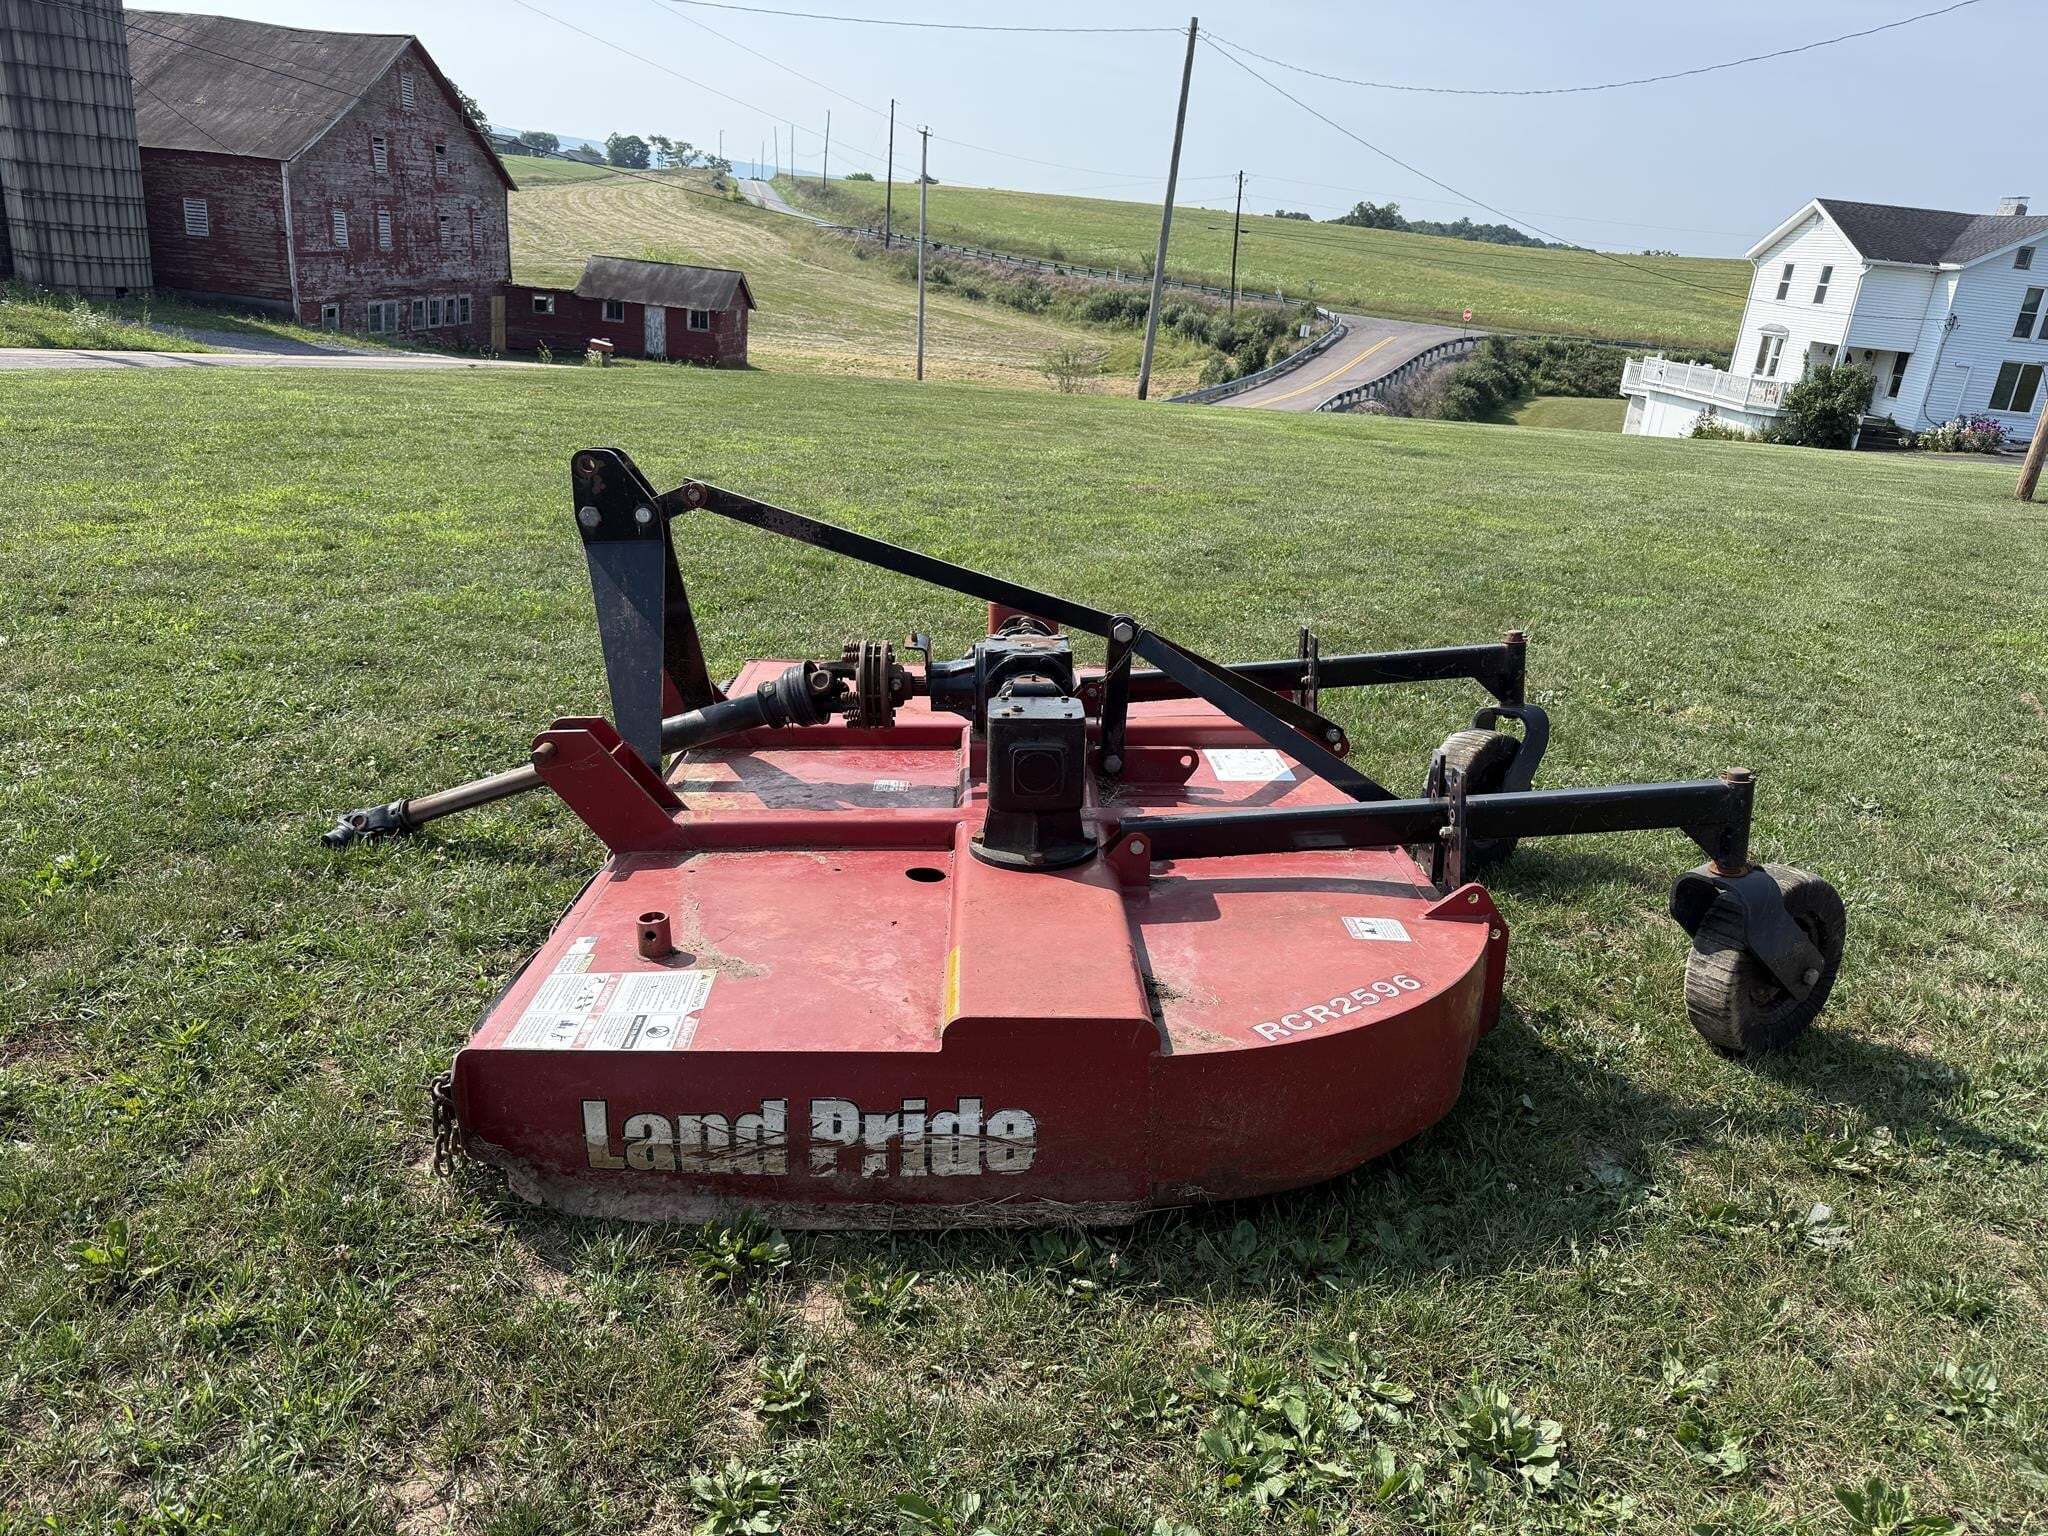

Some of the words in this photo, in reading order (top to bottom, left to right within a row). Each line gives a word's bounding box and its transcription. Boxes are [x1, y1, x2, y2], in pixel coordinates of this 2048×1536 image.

[1252, 974, 1422, 1042] RCR2596
[581, 1098, 788, 1175] Land
[809, 1098, 1038, 1177] Pride
